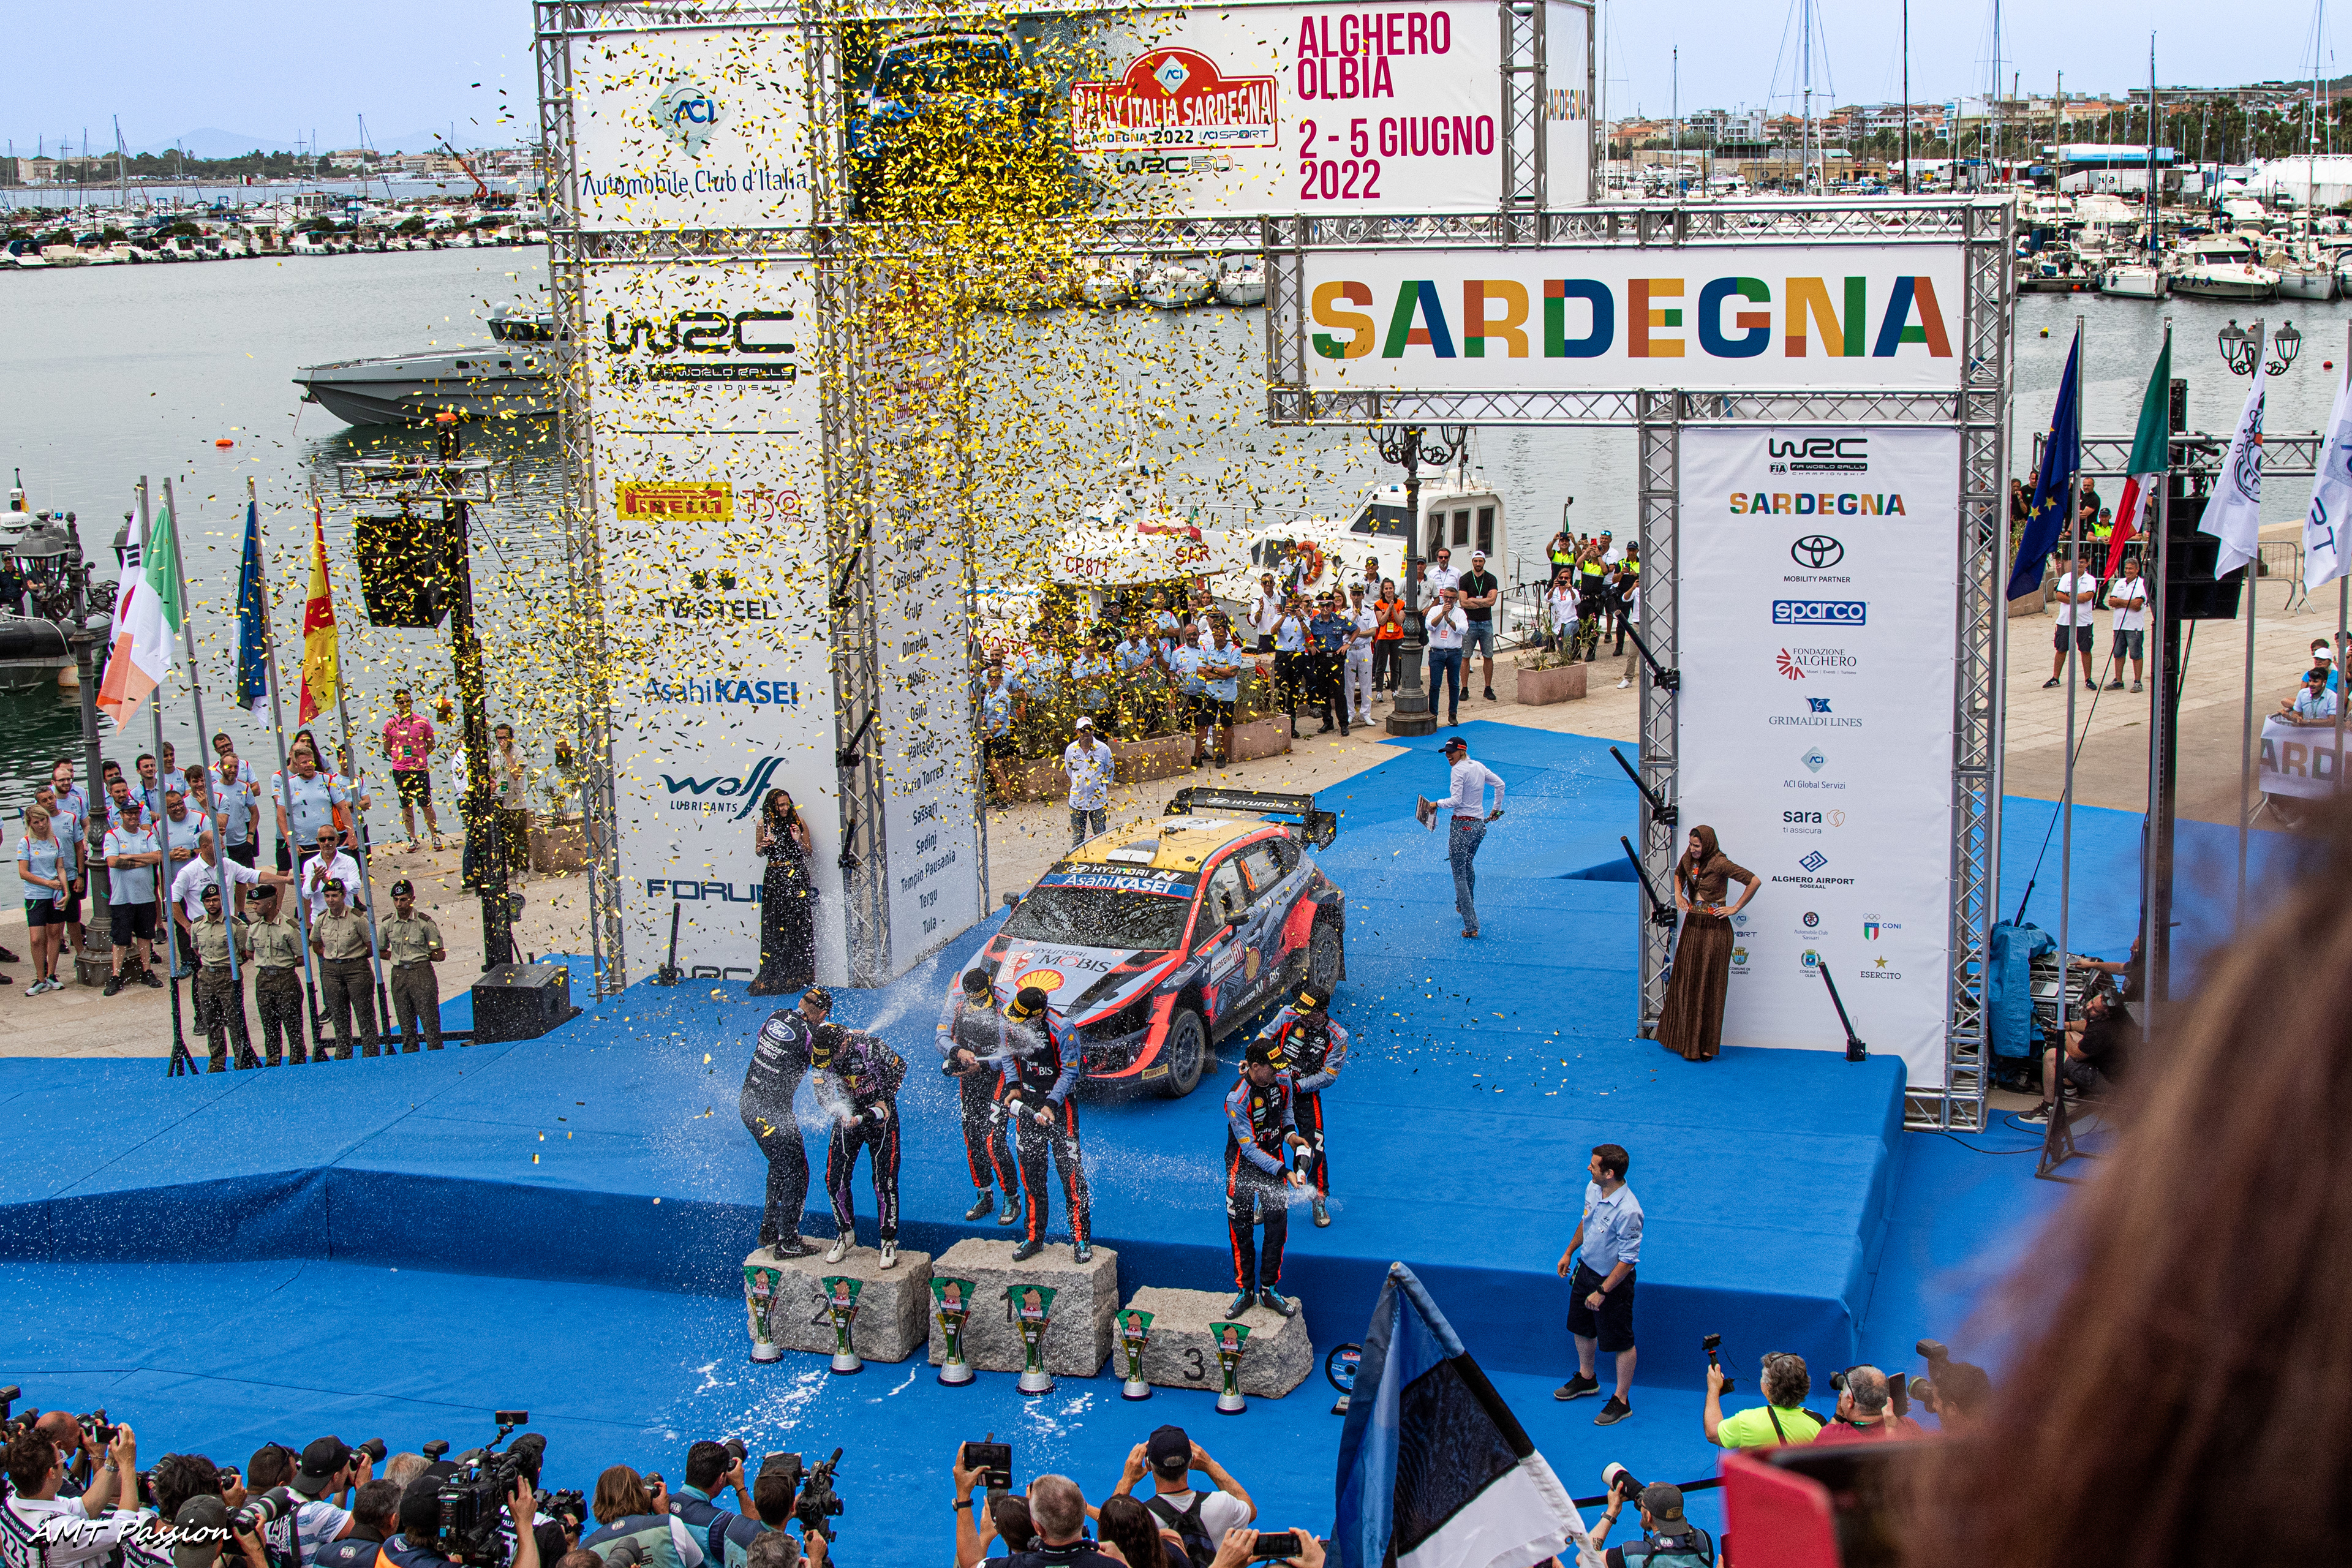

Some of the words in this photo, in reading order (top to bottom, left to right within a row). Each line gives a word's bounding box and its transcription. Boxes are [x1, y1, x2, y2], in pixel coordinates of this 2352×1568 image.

[1297, 10, 1451, 58] ALGHERO
[1165, 69, 1183, 80] ACI
[1297, 56, 1394, 100] OLBIA
[674, 97, 714, 123] ACI
[1074, 88, 1123, 129] RALLY
[1128, 96, 1180, 127] ITALIA
[1183, 82, 1273, 126] SARDEGNA
[1085, 132, 1147, 143] SARDEGNA
[1155, 130, 1194, 145] 2022
[1299, 119, 1317, 159] 2
[1351, 118, 1368, 157] 5
[1379, 115, 1494, 157] GIUGNO
[583, 173, 688, 196] Automobile
[695, 170, 736, 192] Club
[1300, 159, 1381, 200] 2022
[1310, 276, 1954, 358] SARDEGNA
[606, 311, 796, 355] WRC
[1769, 438, 1868, 459] WRC
[625, 489, 723, 514] PIRELLI
[1730, 493, 1906, 516] SARDEGNA
[1175, 544, 1212, 565] SAR
[698, 599, 777, 620] STEEL
[1775, 602, 1864, 623] sparco
[1794, 655, 1857, 666] ALGHERO
[1769, 716, 1828, 726] GRIMALDI
[1830, 718, 1863, 727] LINES
[671, 801, 737, 812] LUBRICANTS
[913, 800, 938, 826] Sassari
[1232, 799, 1288, 809] HYUNDAI
[1783, 811, 1822, 823] sara
[916, 830, 937, 856] Sedini
[900, 870, 924, 894] Tempio
[925, 849, 956, 878] Pausania
[1092, 865, 1150, 876] HYUNDAI
[1240, 861, 1255, 891] 8
[1063, 875, 1172, 894] AsahiKASEI
[919, 889, 938, 910] Tergu
[923, 917, 937, 935] Tula
[1031, 948, 1088, 957] HYUNDAI
[1210, 952, 1233, 974] SARDEGNA
[1038, 954, 1112, 973] MOBIS
[768, 1022, 789, 1038] Ford
[858, 1080, 876, 1097] Bull
[811, 1294, 831, 1327] 2
[1000, 1292, 1013, 1324] 1
[1183, 1348, 1205, 1382] 3
[670, 1502, 681, 1513] FIA
[611, 1520, 625, 1530] FIA
[341, 1547, 355, 1558] FIA
[1659, 1537, 1673, 1547] FIA
